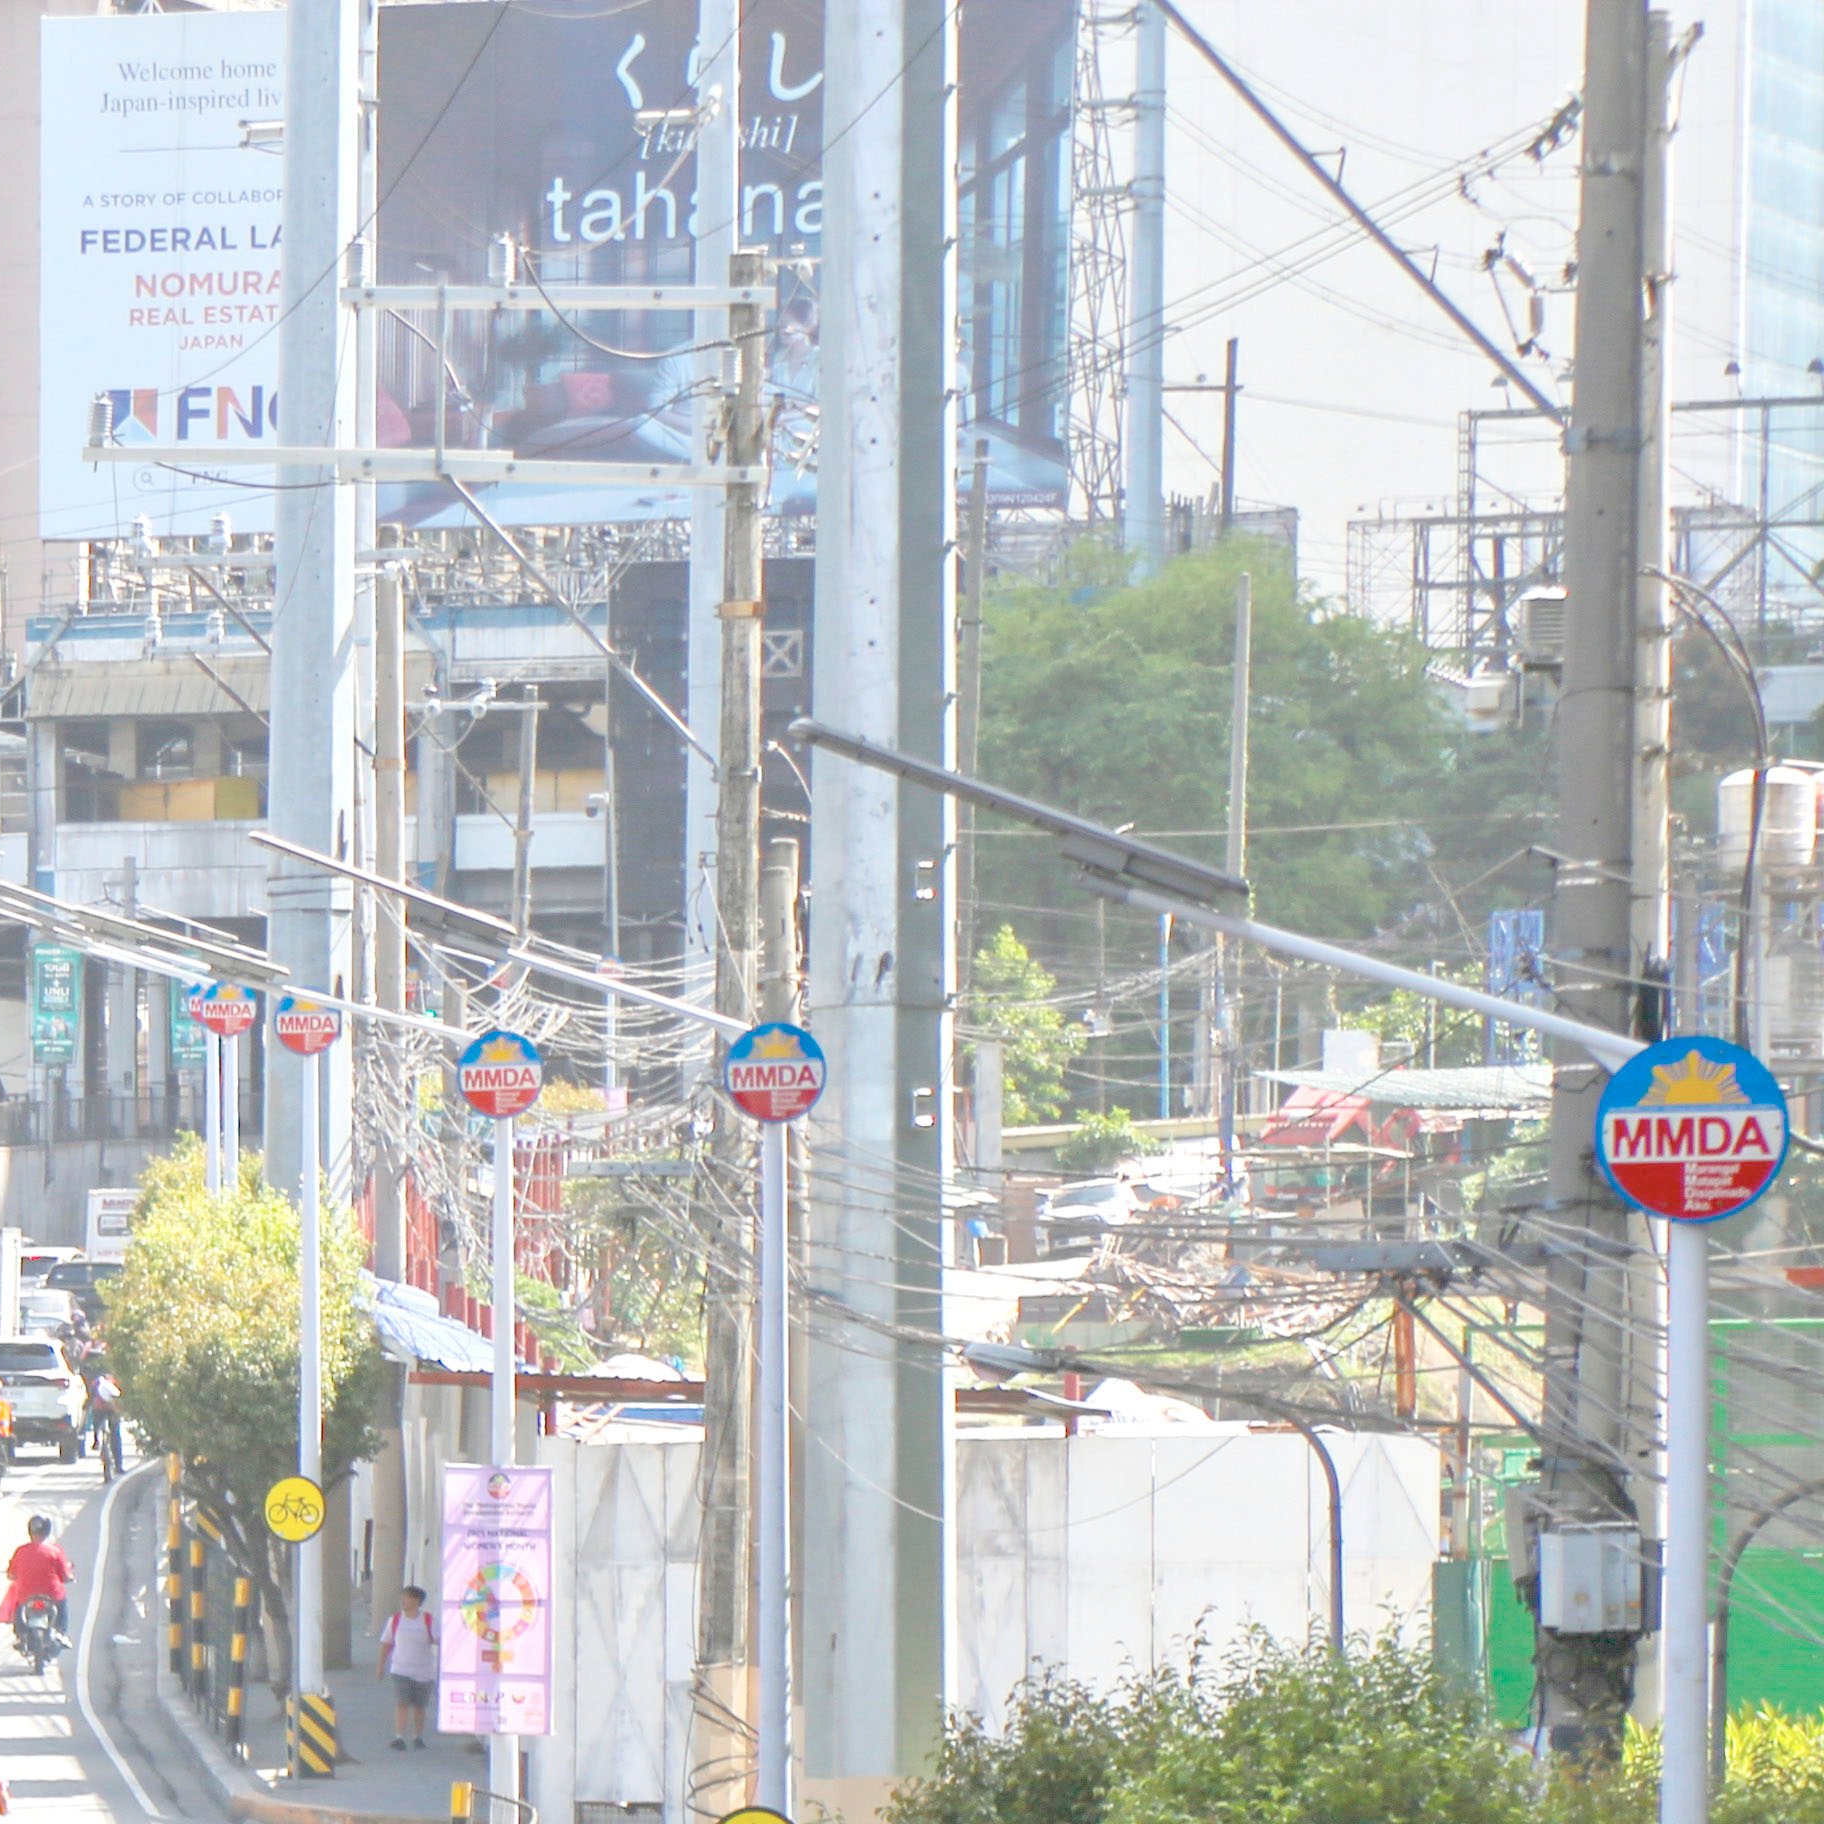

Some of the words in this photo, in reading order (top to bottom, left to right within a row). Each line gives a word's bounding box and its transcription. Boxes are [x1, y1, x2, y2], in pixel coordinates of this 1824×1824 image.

[119, 61, 213, 85] Welcome
[221, 60, 277, 79] home
[616, 33, 824, 109] くし
[100, 89, 251, 117] Japan-inspired
[83, 194, 95, 207] A
[101, 193, 156, 207] STORY
[163, 192, 186, 206] OF
[546, 171, 824, 242] tahna
[81, 226, 238, 254] FEDERAL
[129, 306, 194, 327] REAL
[179, 335, 244, 351] JAPAN
[205, 1003, 252, 1018] MMDA
[279, 1016, 335, 1032] MMDA
[464, 1068, 536, 1088] MMDA
[731, 1065, 817, 1088] MMDA
[1613, 1116, 1772, 1158] MMDA
[1684, 1162, 1741, 1176] Marangal
